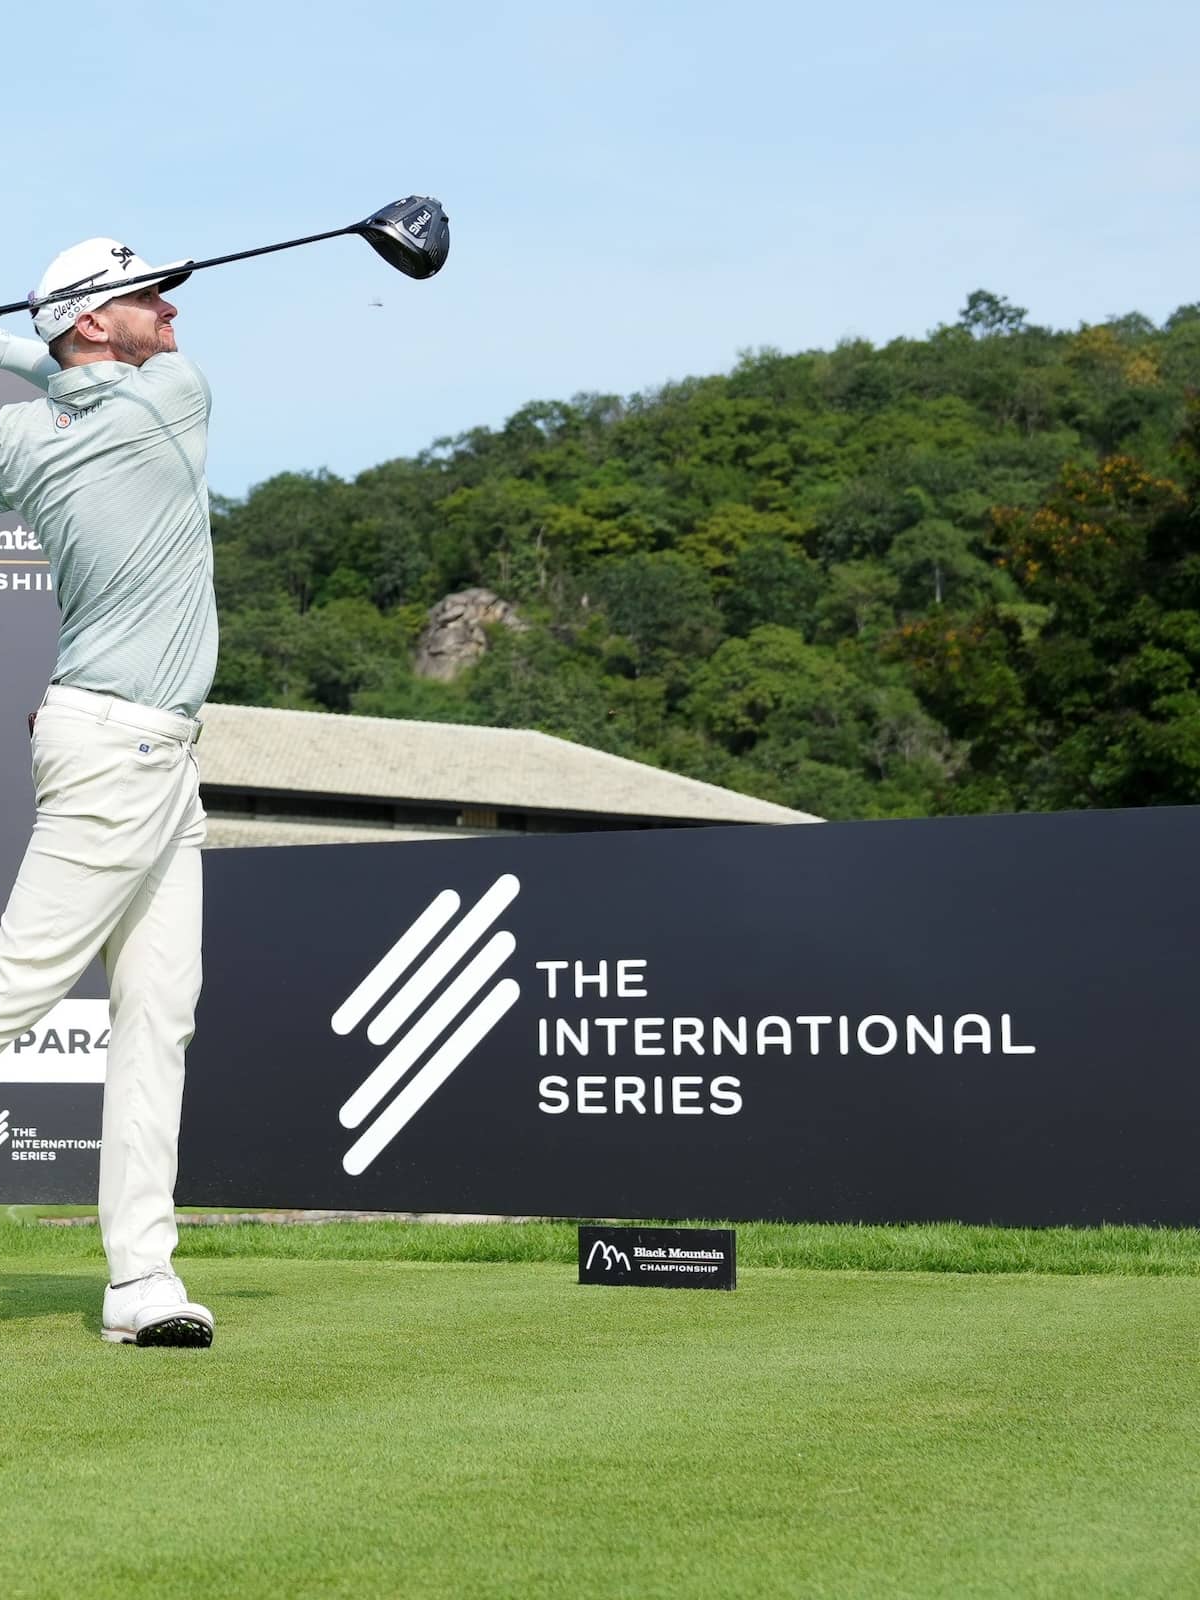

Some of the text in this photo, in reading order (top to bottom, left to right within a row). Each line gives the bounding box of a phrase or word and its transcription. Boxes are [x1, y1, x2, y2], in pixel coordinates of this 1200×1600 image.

[408, 209, 432, 236] PING
[68, 297, 92, 319] GOLF
[535, 959, 648, 999] THE
[538, 1013, 1037, 1057] INTERNATIONAL
[538, 1075, 743, 1116] SERIES
[11, 1127, 38, 1138] THE
[11, 1139, 104, 1150] INTERNATIONA
[11, 1150, 57, 1161] SERIES
[633, 1246, 725, 1260] Black Mountain
[639, 1263, 719, 1273] CHAMPIONSHIP
